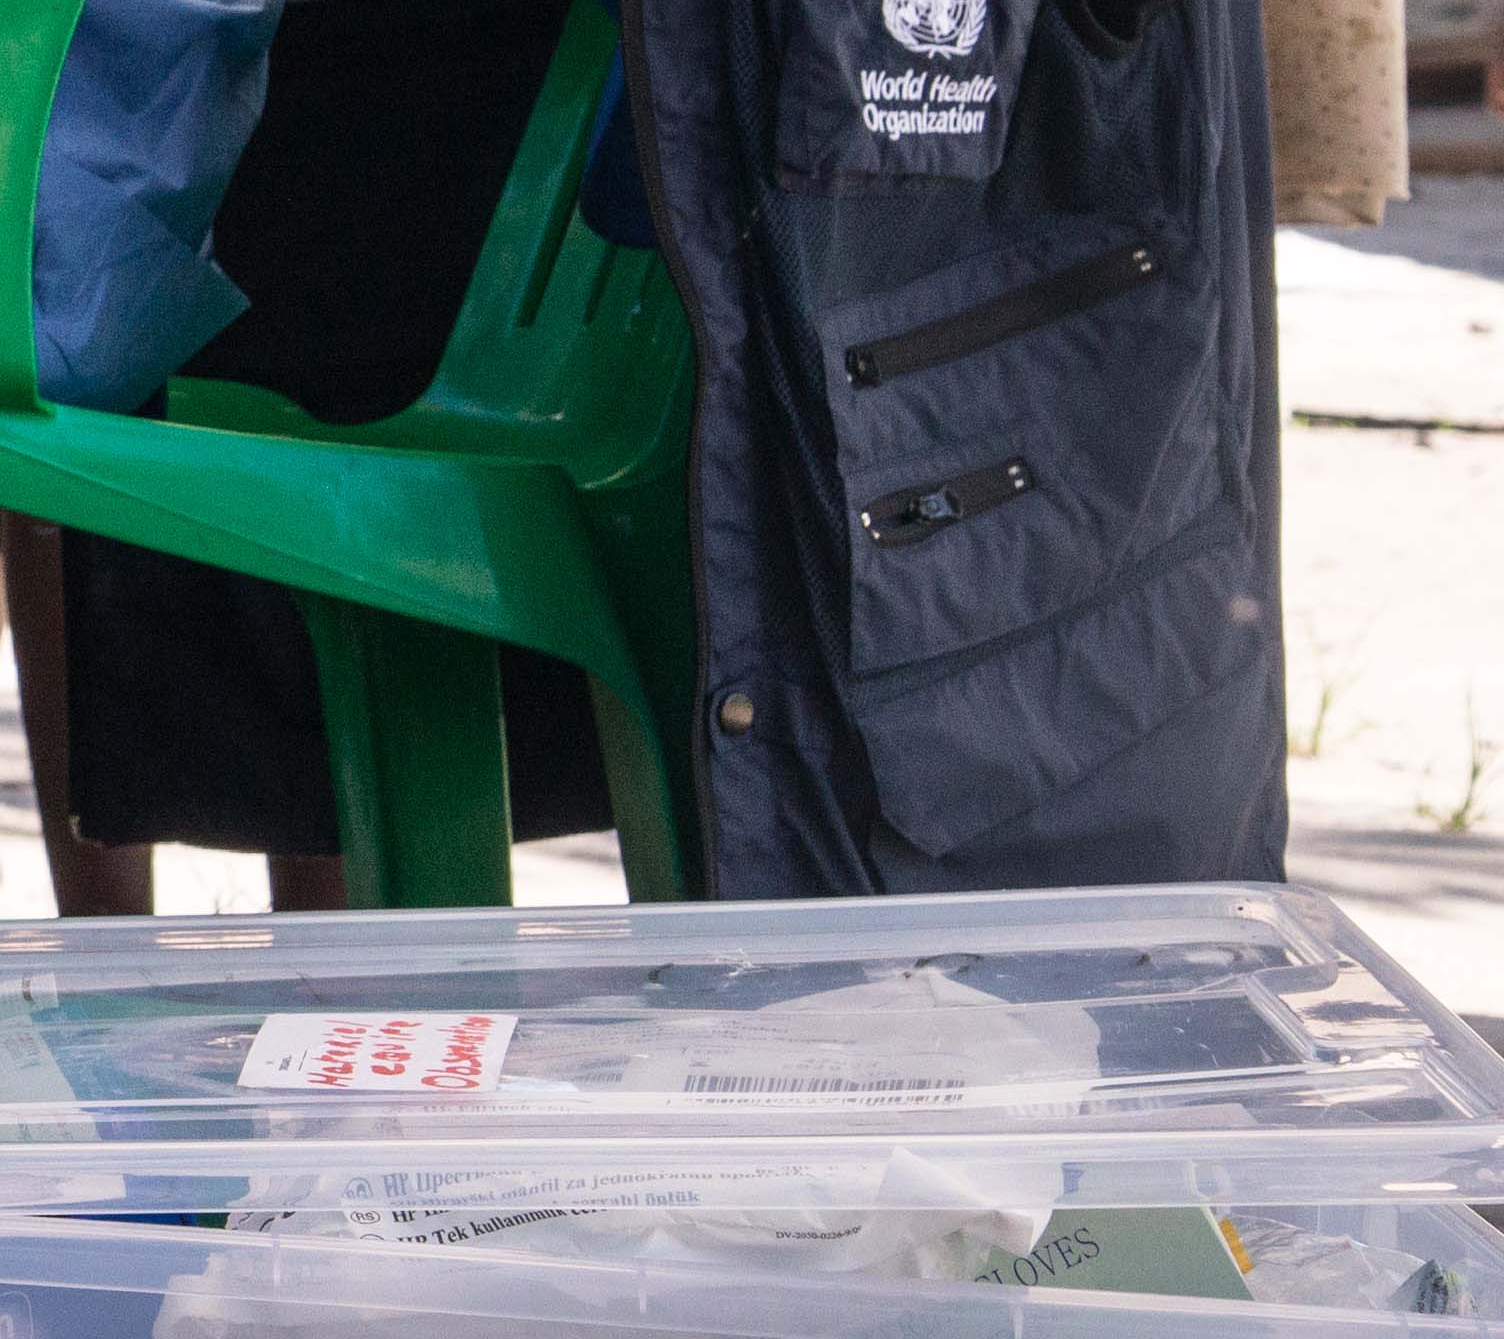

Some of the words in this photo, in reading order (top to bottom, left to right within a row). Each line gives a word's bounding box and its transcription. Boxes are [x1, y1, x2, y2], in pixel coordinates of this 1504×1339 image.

[860, 69, 926, 101] World
[929, 74, 998, 103] Health
[862, 102, 986, 141] Organization
[432, 1226, 469, 1245] Tek
[974, 1226, 1102, 1287] OVES
